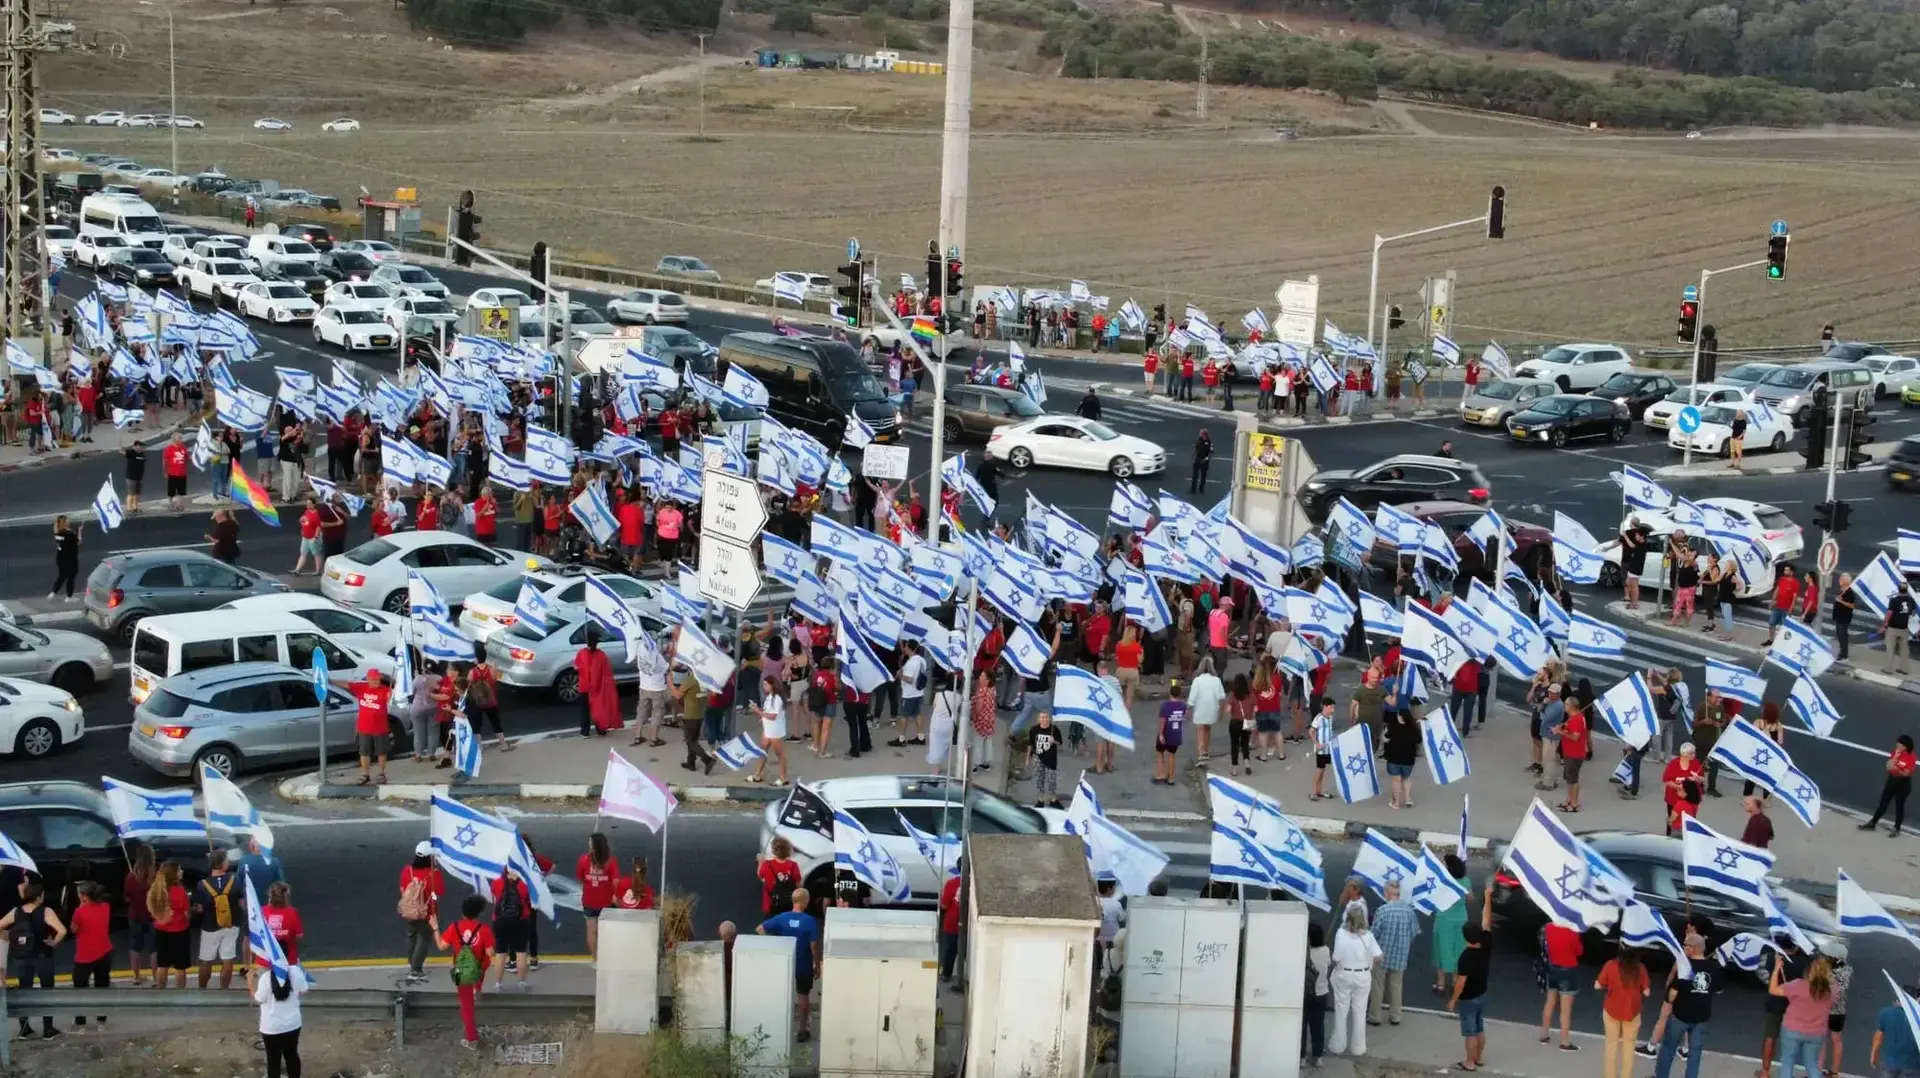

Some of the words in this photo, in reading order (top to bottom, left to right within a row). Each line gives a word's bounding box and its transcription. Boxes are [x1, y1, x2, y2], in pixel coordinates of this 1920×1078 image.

[716, 481, 740, 498] עפולה
[1248, 475, 1281, 488] המשיח
[715, 514, 737, 532] Afula
[707, 577, 737, 597] Nahalal
